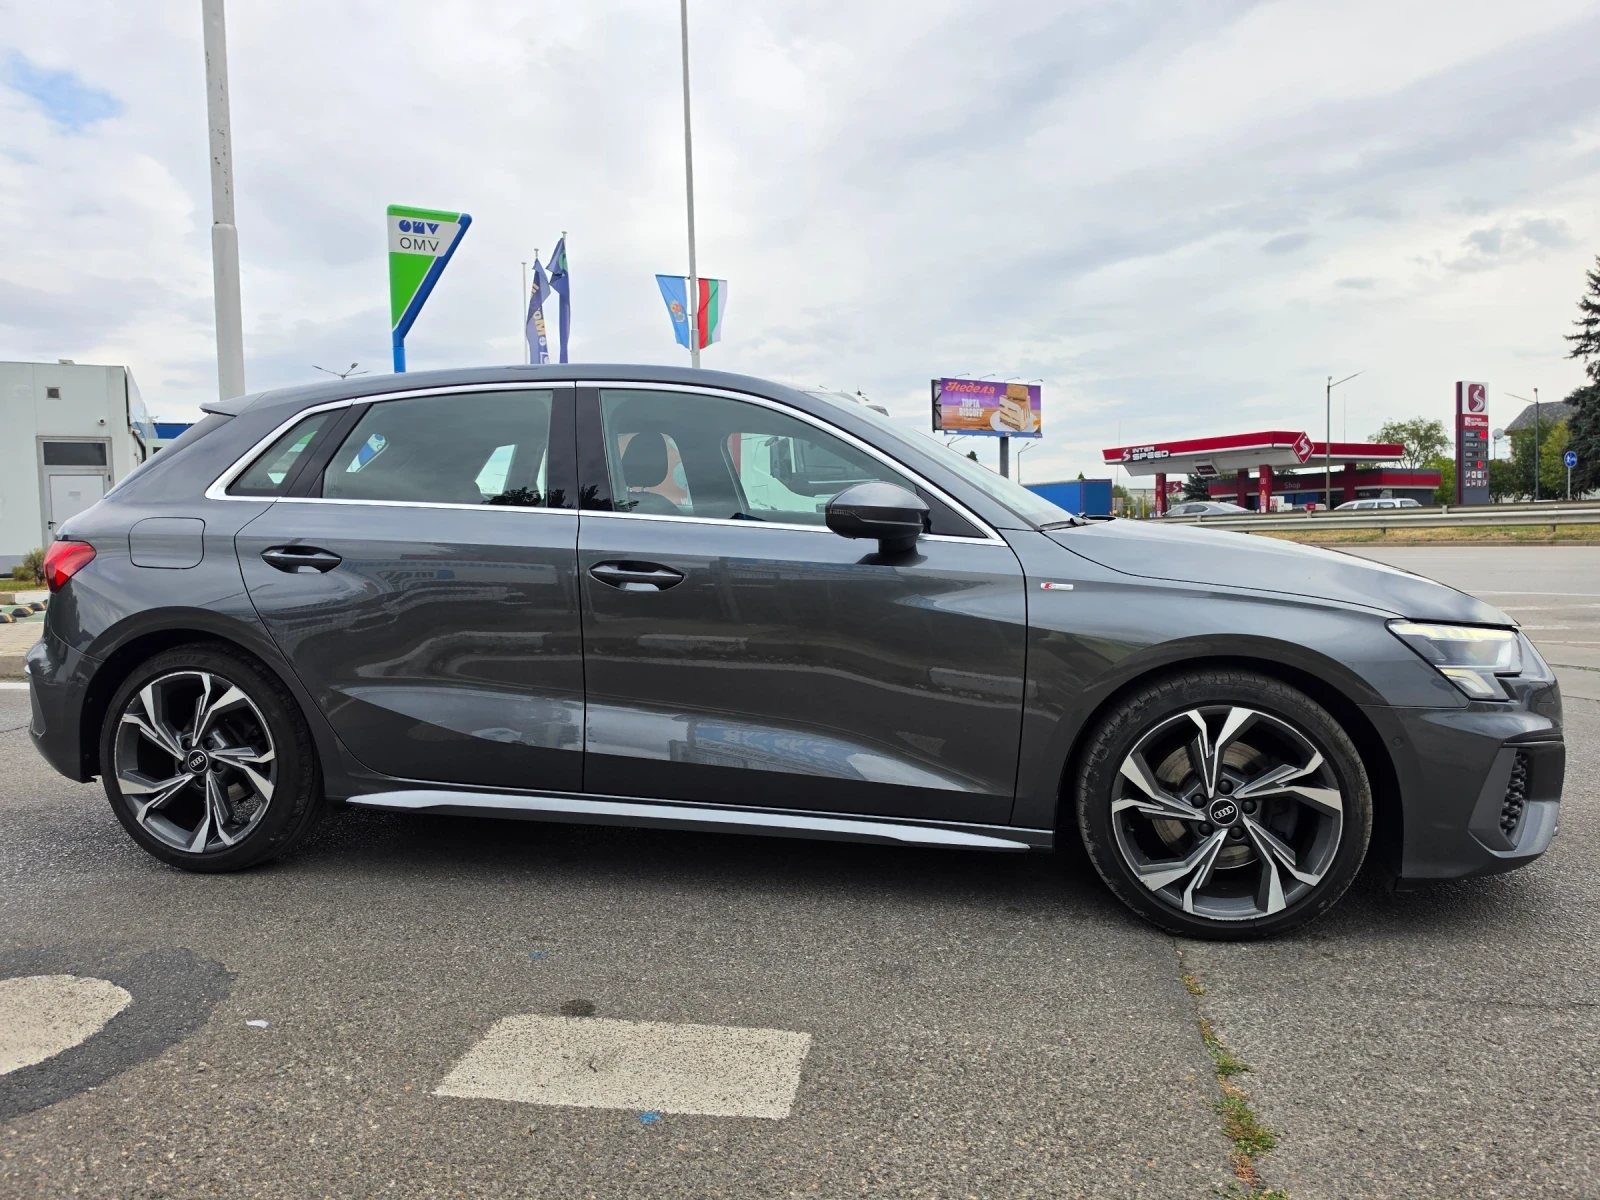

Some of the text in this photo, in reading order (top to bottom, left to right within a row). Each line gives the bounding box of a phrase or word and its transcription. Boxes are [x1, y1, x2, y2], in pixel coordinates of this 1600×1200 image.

[400, 237, 440, 252] OMV
[945, 382, 995, 394] Неделя
[1132, 450, 1169, 461] SPEED
